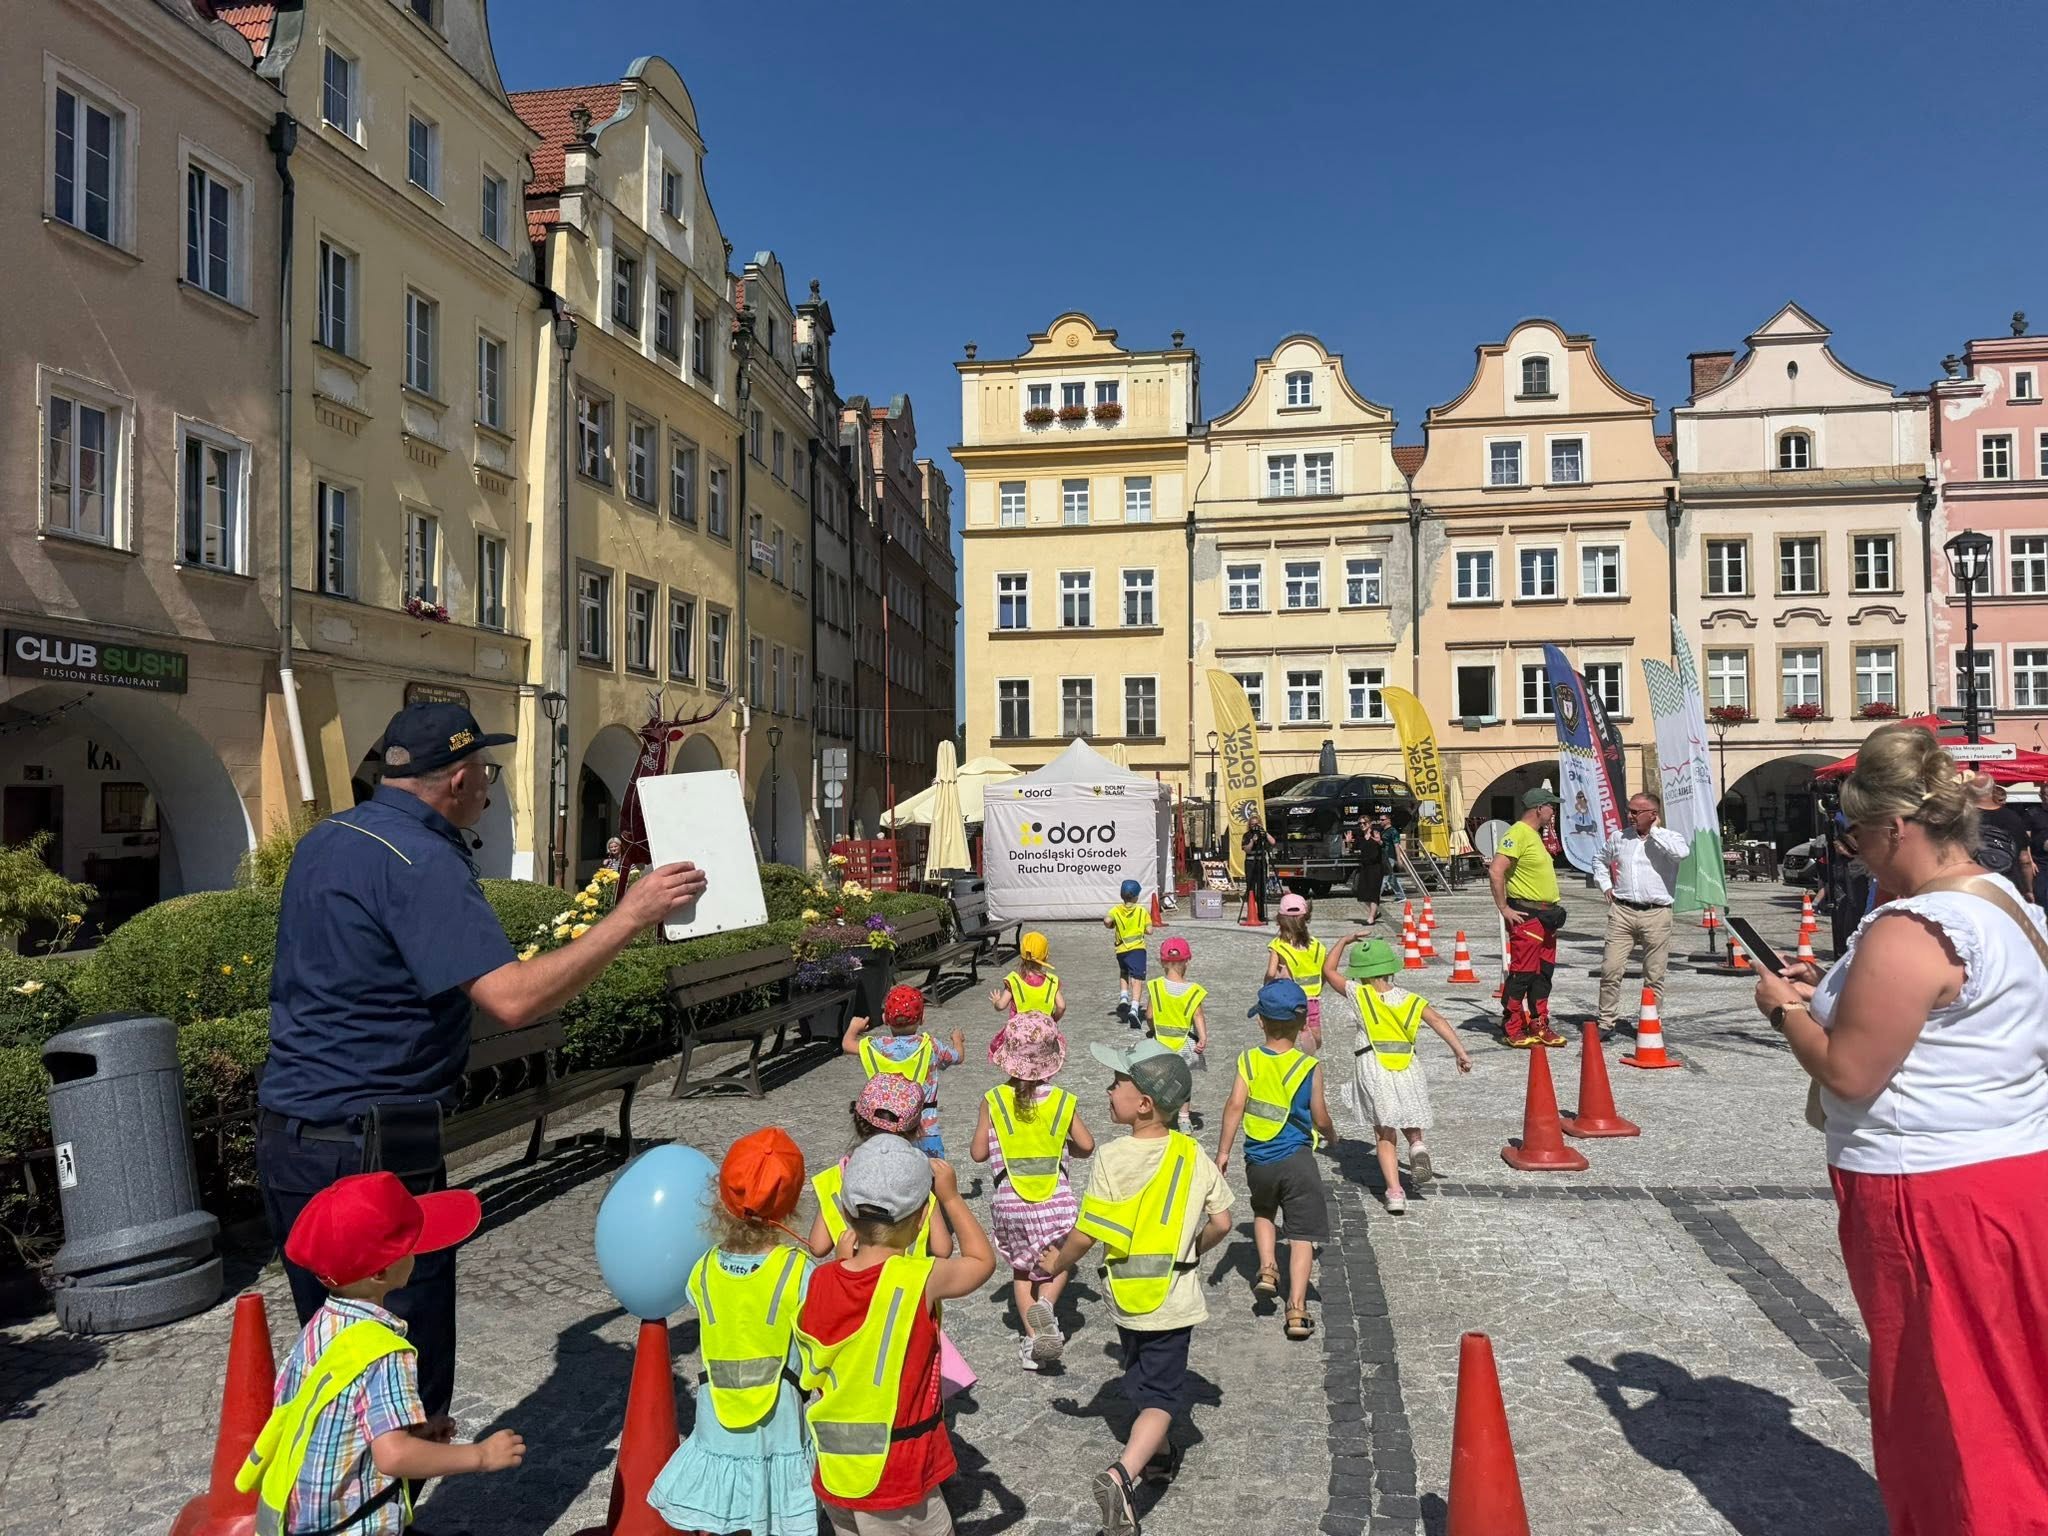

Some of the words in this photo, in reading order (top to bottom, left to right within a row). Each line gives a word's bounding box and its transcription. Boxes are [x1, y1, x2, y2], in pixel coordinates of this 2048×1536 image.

[15, 636, 98, 668] CLUB
[102, 648, 184, 678] SUSHI
[43, 667, 87, 681] FUSION
[90, 672, 161, 688] RESTAURANT
[1024, 787, 1052, 798] dord
[1047, 820, 1116, 844] dord
[1009, 849, 1075, 861] Dolnośląski
[1077, 847, 1127, 858] Ośrodek
[1018, 863, 1054, 875] Ruchu
[1057, 862, 1122, 875] Drogowego
[729, 1264, 749, 1276] Kitty
